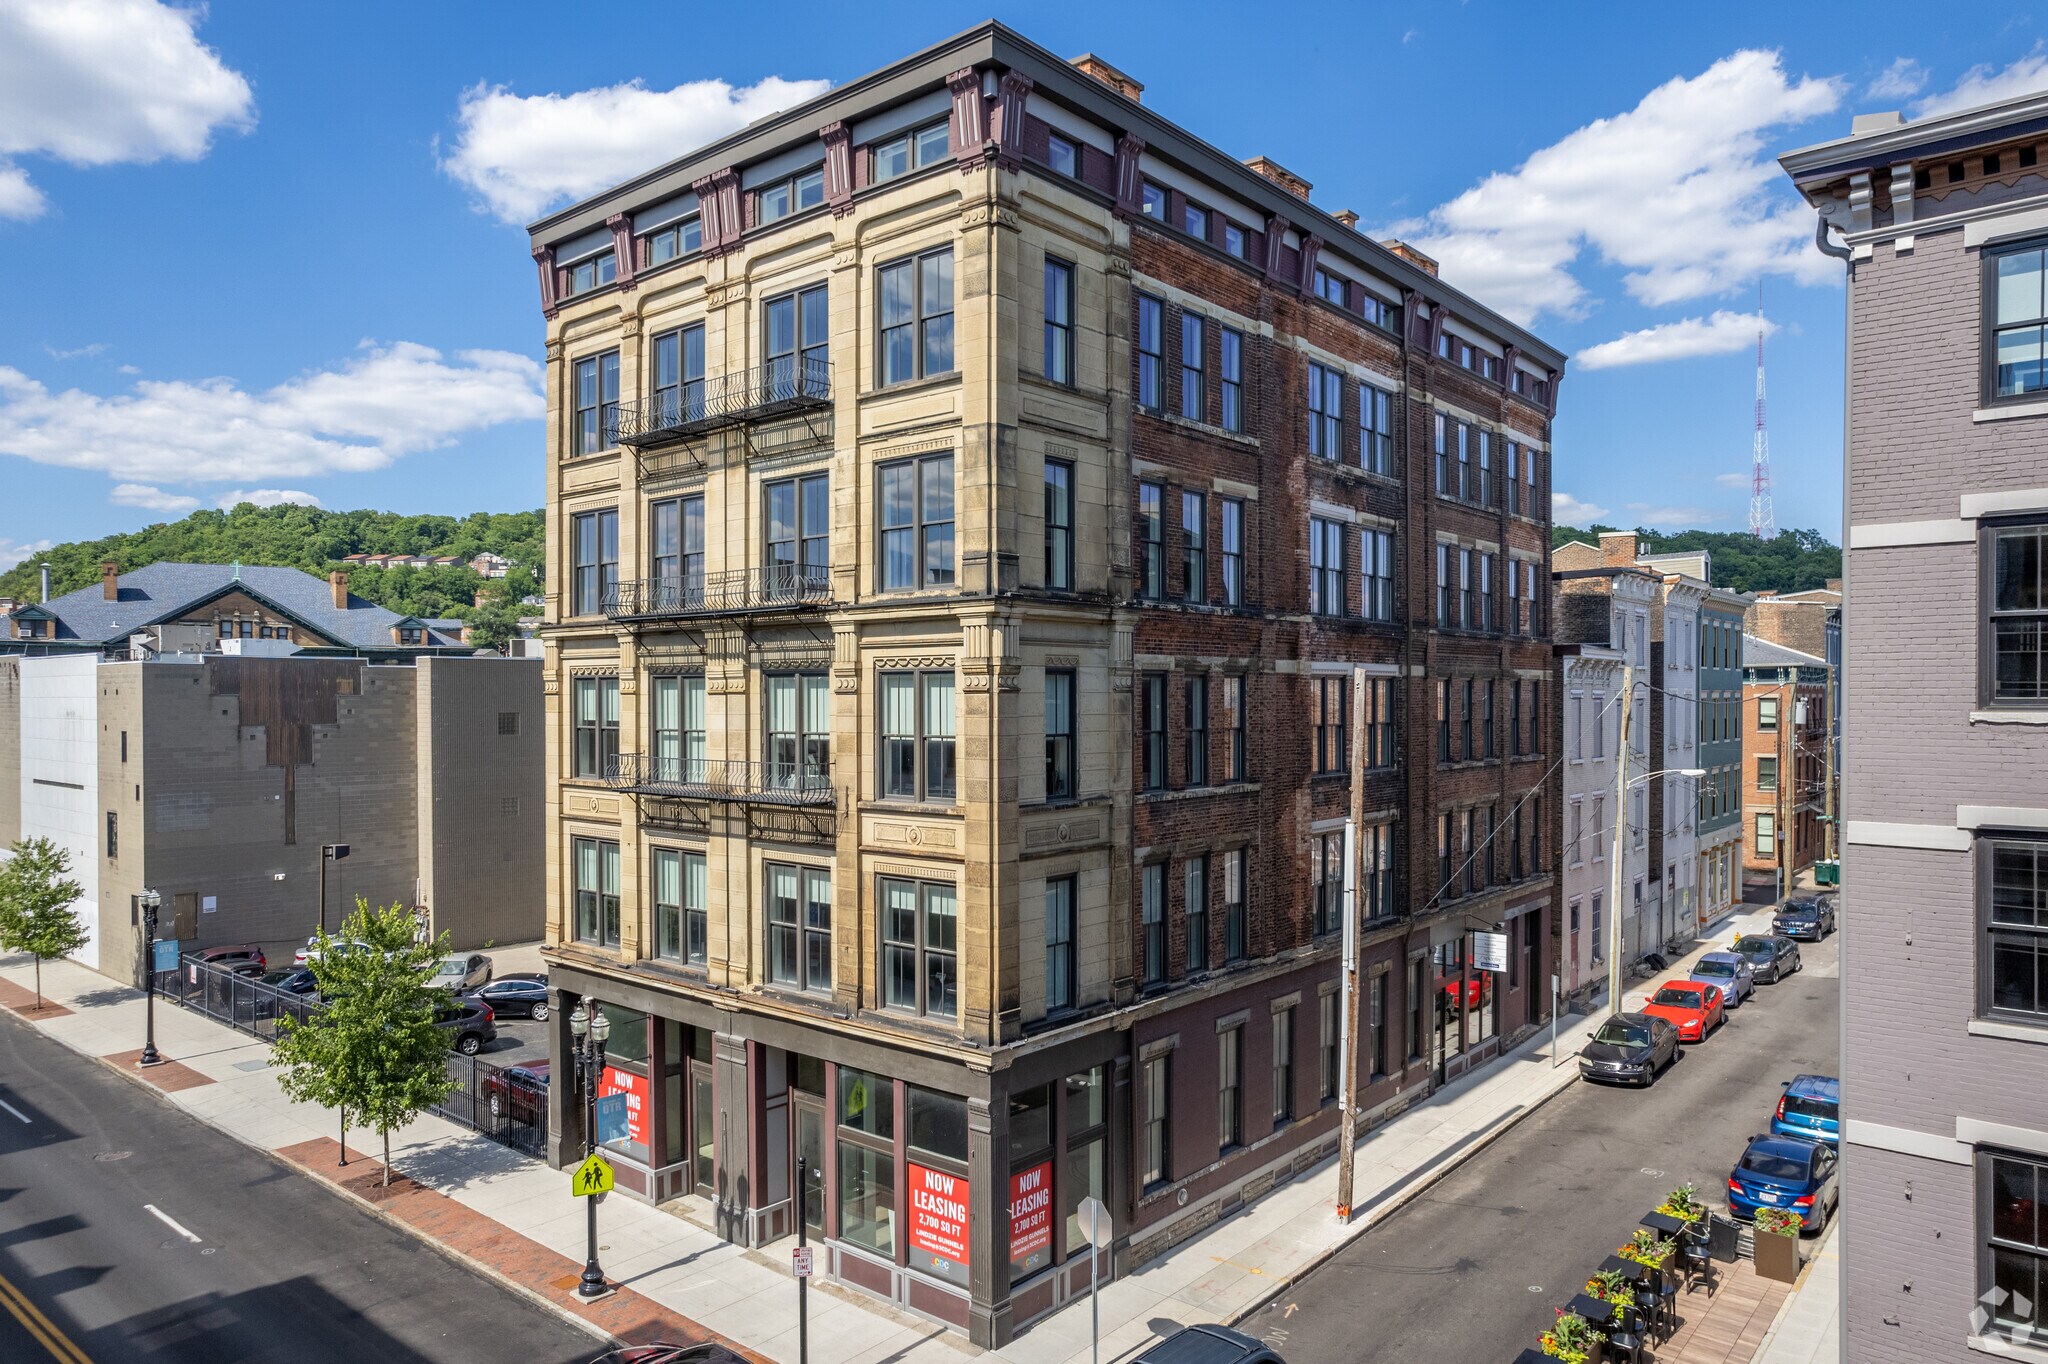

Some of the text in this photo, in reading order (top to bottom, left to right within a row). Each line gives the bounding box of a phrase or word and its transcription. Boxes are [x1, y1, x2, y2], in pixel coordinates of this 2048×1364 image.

[614, 1070, 634, 1089] NOW
[608, 1086, 641, 1111] LING
[632, 1112, 638, 1121] FT
[925, 1170, 954, 1196] NOW
[1019, 1169, 1041, 1193] NOW
[914, 1188, 966, 1223] LEASING
[1011, 1187, 1049, 1220] LEASING
[919, 1212, 961, 1237] 2,700 SQ FT
[1014, 1210, 1046, 1234] 2,700 SQ FT
[915, 1228, 964, 1251] LINDZIE GUNNELS
